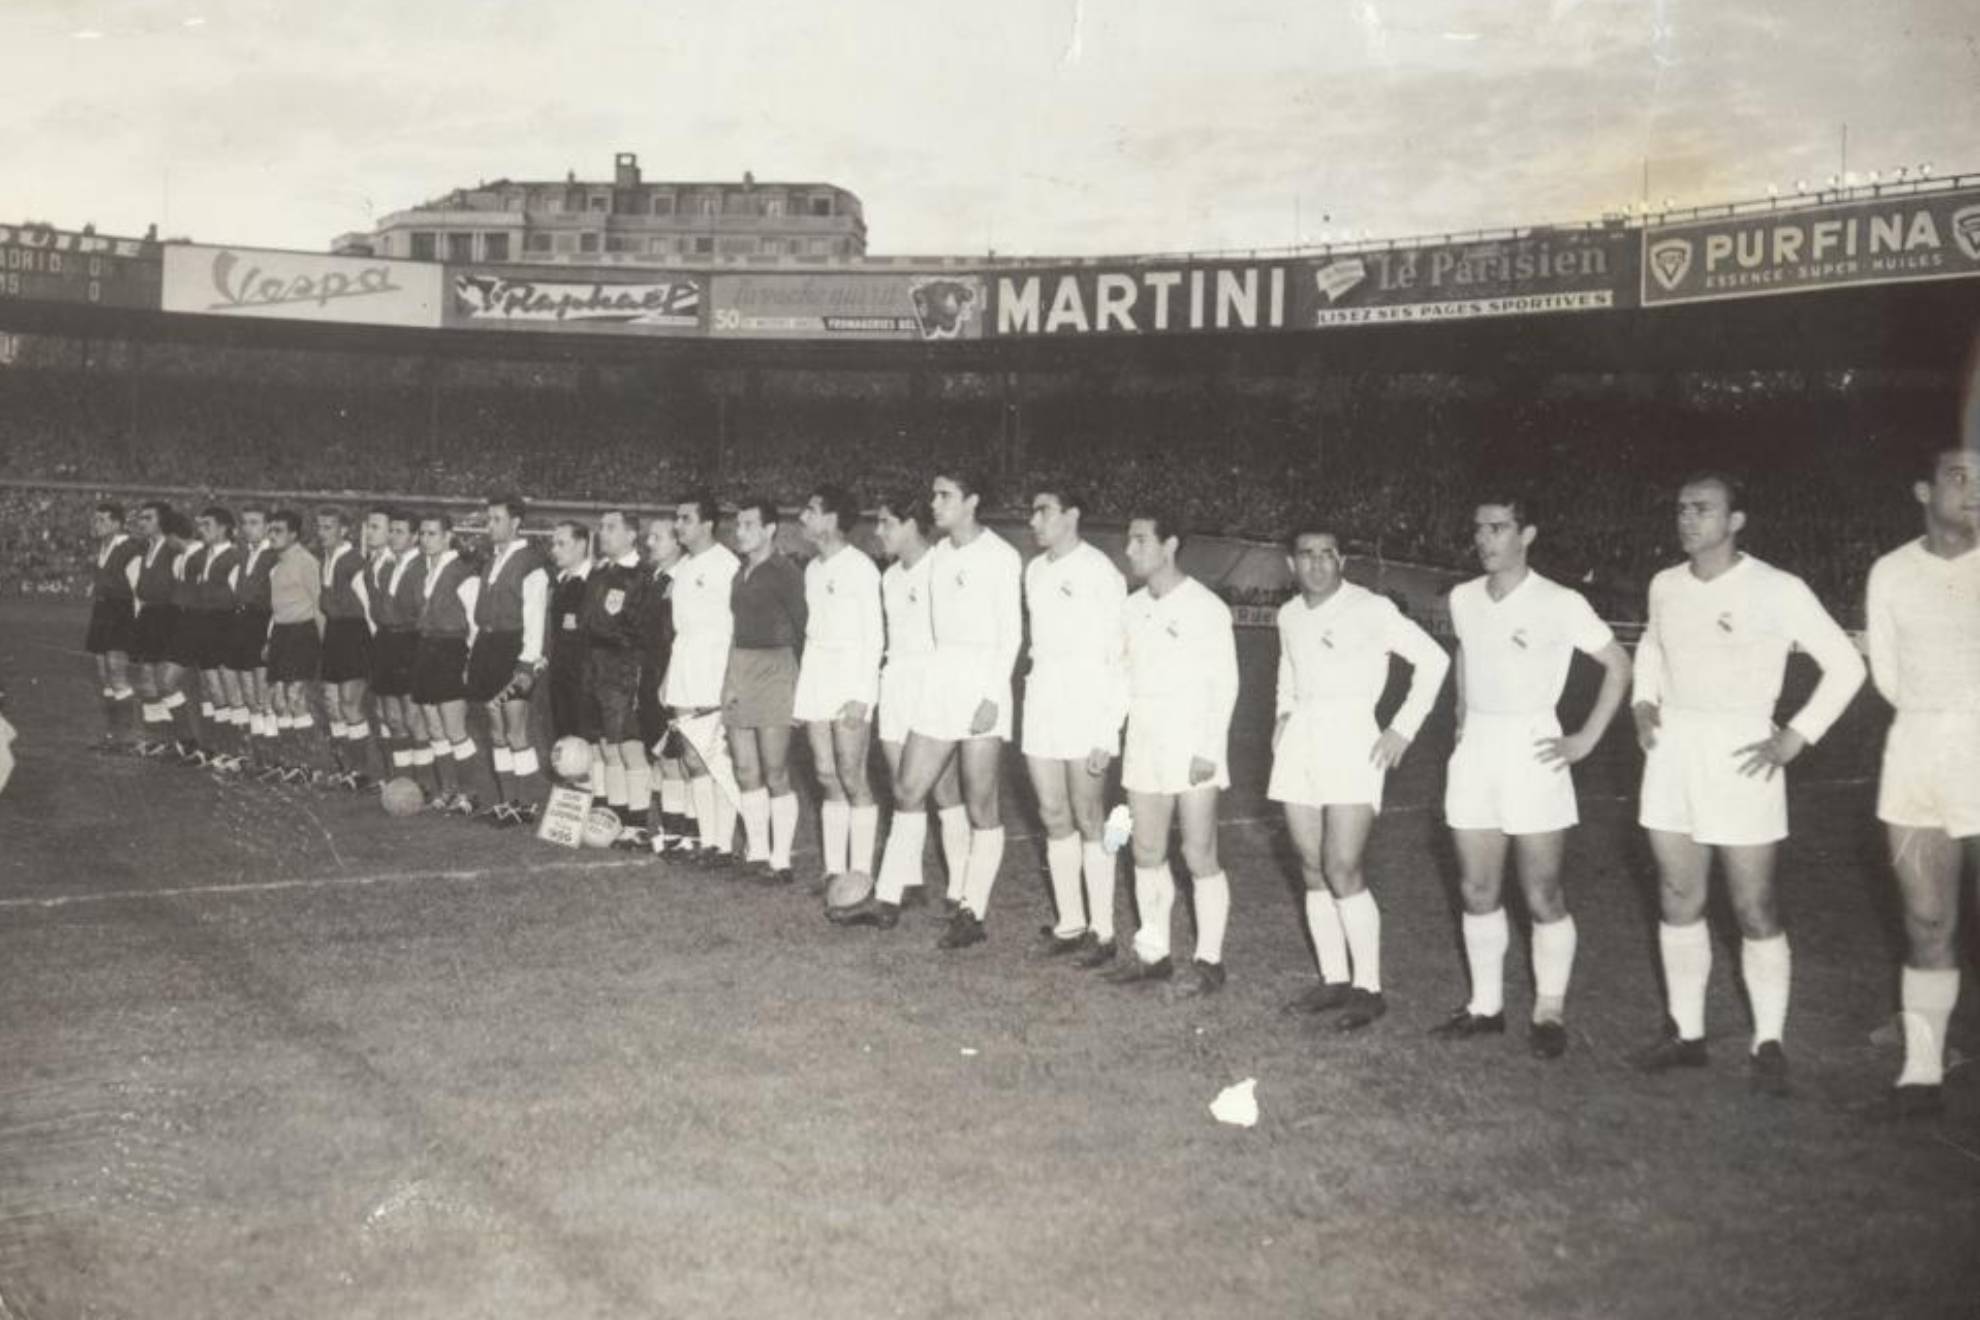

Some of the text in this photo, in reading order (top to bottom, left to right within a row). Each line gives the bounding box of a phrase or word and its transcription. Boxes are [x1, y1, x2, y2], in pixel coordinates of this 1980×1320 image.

[1706, 210, 1940, 272] PURFINA
[209, 251, 401, 308] Vespa
[1377, 242, 1608, 291] Le Parisien
[1705, 269, 1783, 289] ESSENCE
[714, 309, 740, 330] 50
[998, 267, 1285, 334] MARTINI
[1319, 294, 1608, 324] LISEZ SES PAGES SPORTIVES
